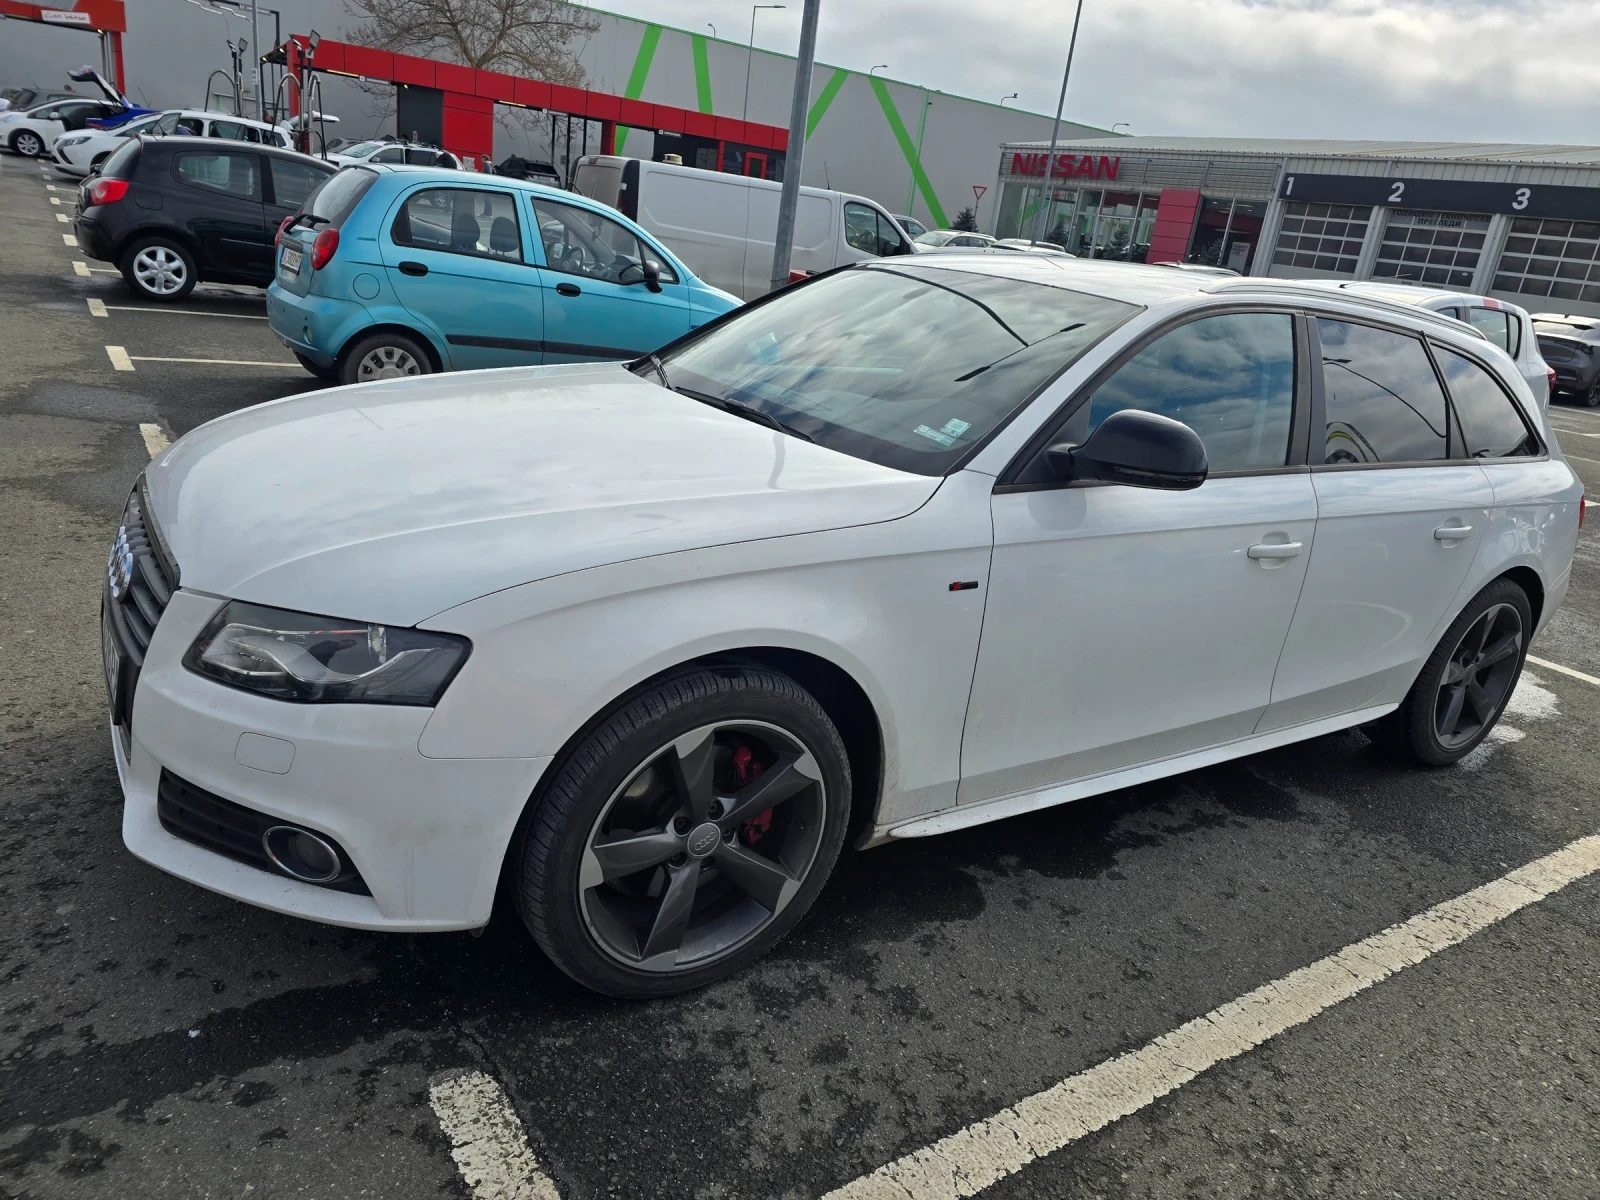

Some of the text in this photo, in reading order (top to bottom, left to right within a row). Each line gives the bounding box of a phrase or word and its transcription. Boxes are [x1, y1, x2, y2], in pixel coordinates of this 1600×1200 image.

[1011, 152, 1120, 181] NISSAN
[1286, 176, 1295, 196] 1
[1387, 181, 1405, 202] 2
[1511, 187, 1531, 210] 3
[1417, 218, 1462, 228] ПРЕГЛЕДИ
